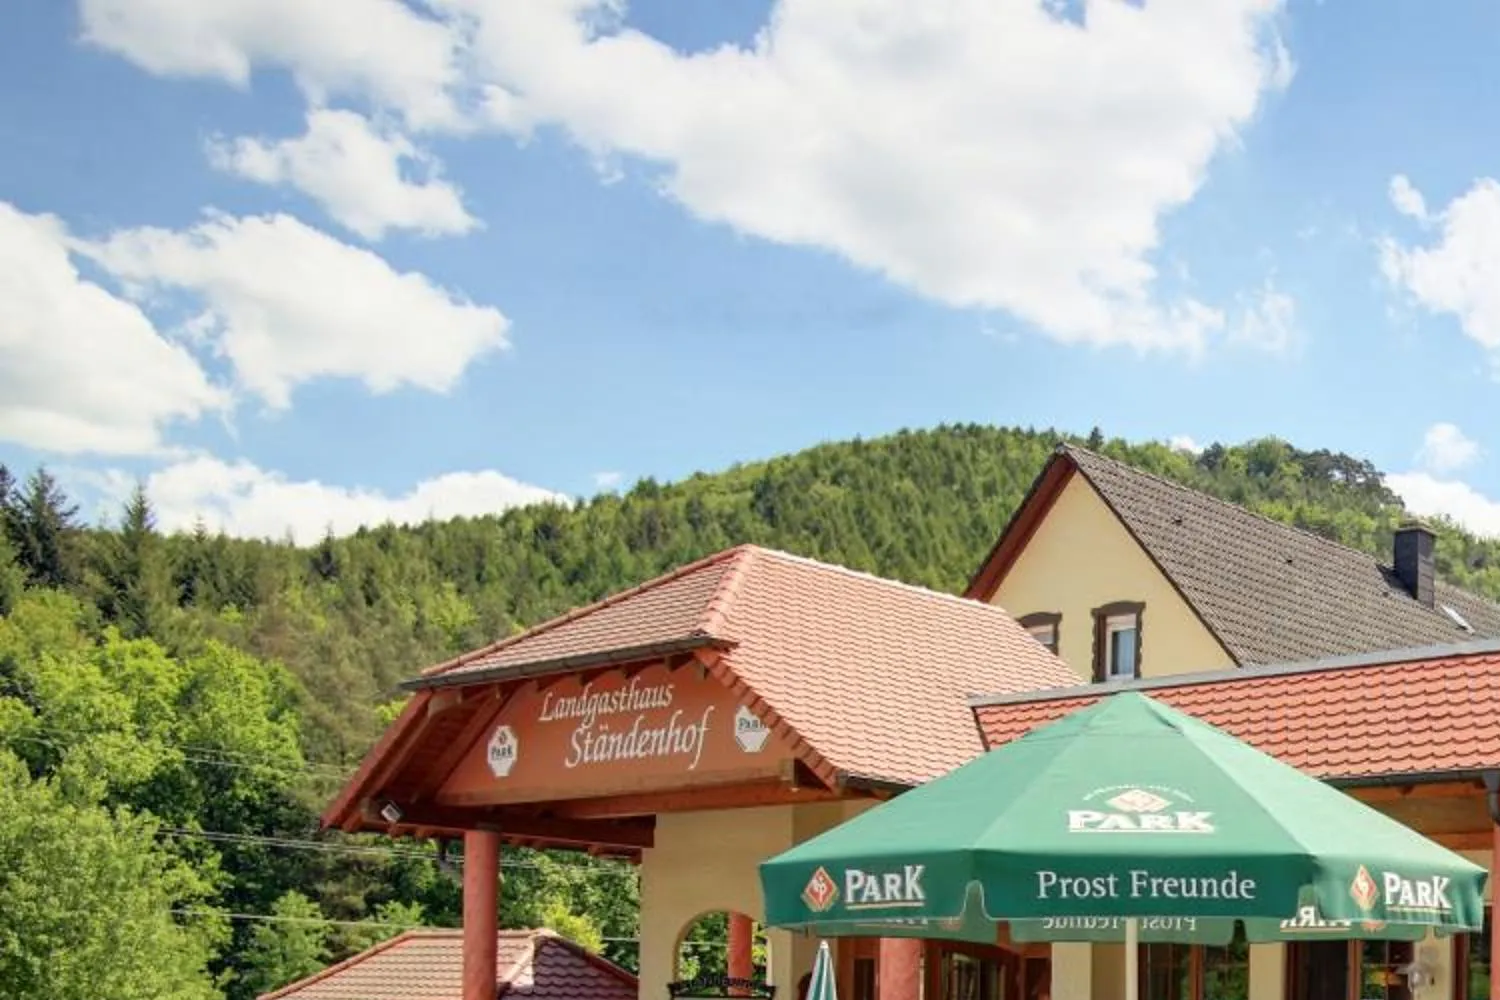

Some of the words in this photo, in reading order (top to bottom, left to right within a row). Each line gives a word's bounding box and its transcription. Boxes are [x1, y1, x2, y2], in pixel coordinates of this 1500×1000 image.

[538, 675, 675, 728] Landgasthaus
[564, 705, 716, 770] Ständenhof
[1067, 810, 1214, 830] PARK
[844, 864, 926, 903] PARK
[1036, 870, 1119, 899] Prost
[1128, 869, 1257, 900] Freunde
[1383, 870, 1452, 908] PARK
